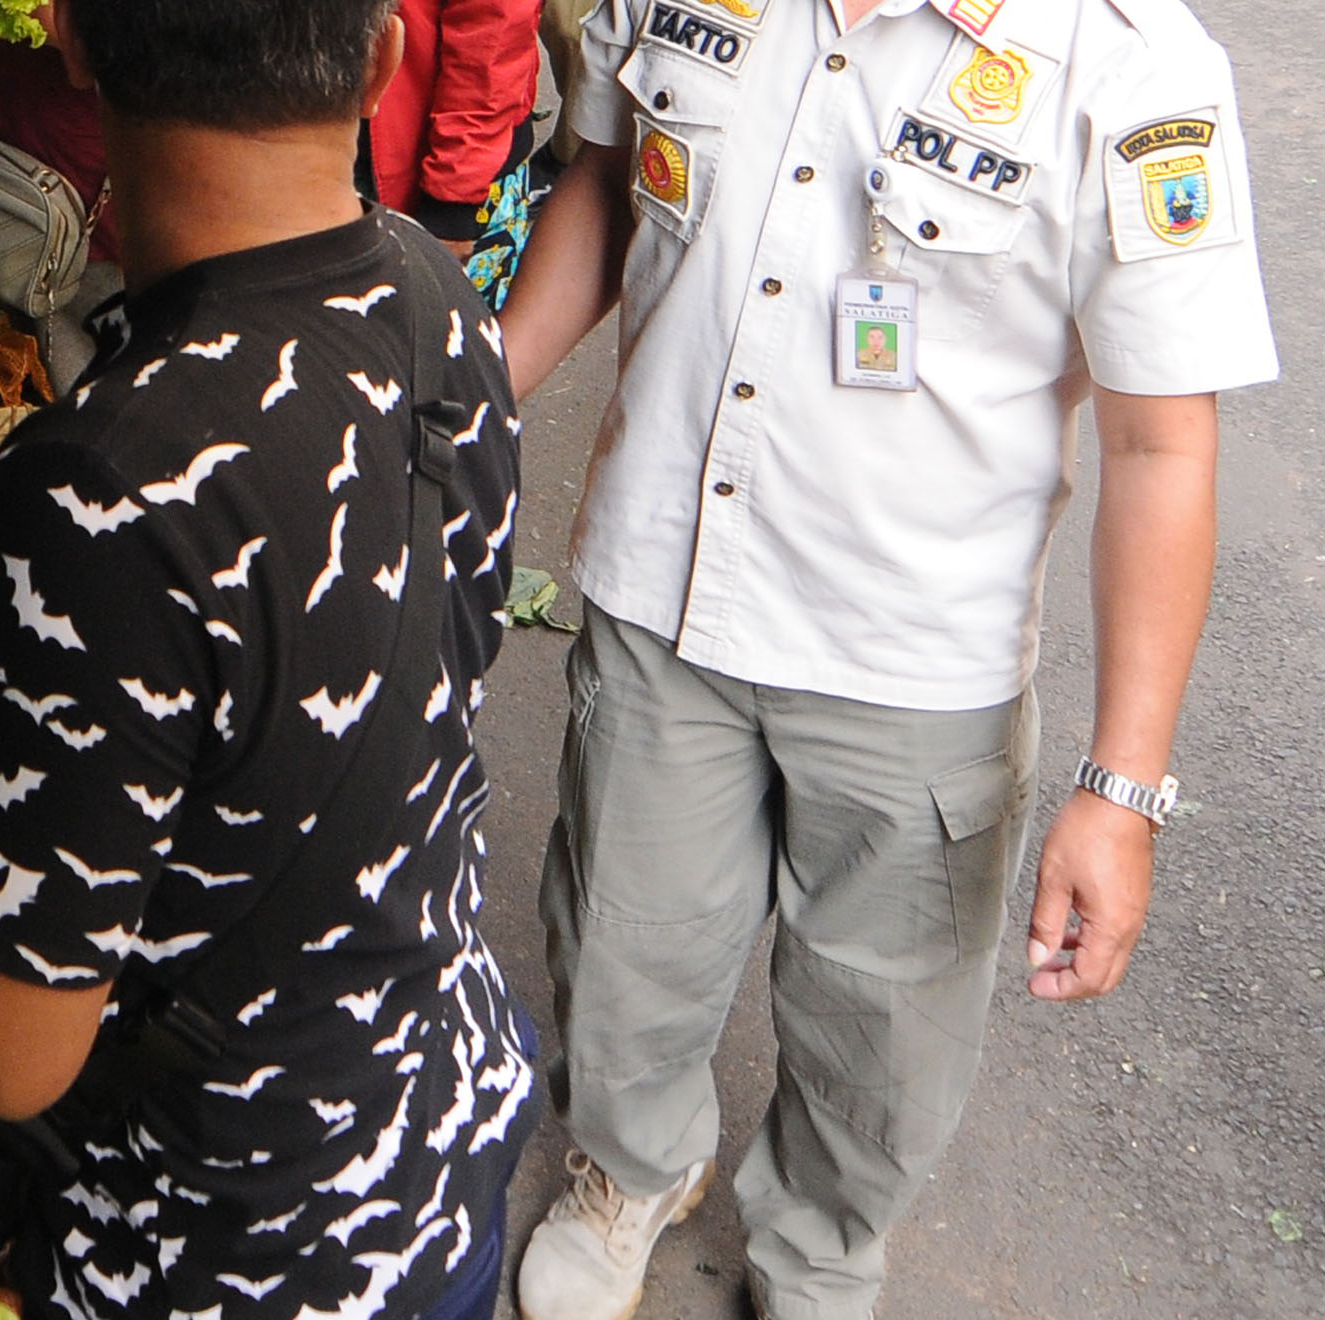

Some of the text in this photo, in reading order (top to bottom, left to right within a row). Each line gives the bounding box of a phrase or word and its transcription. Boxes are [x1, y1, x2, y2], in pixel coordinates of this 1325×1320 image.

[651, 2, 741, 63] TARTO
[896, 118, 1022, 191] POL PP
[1126, 125, 1205, 155] KOTA SALATIGA
[1144, 156, 1203, 176] SALATIGA
[844, 308, 909, 319] SALATIGA
